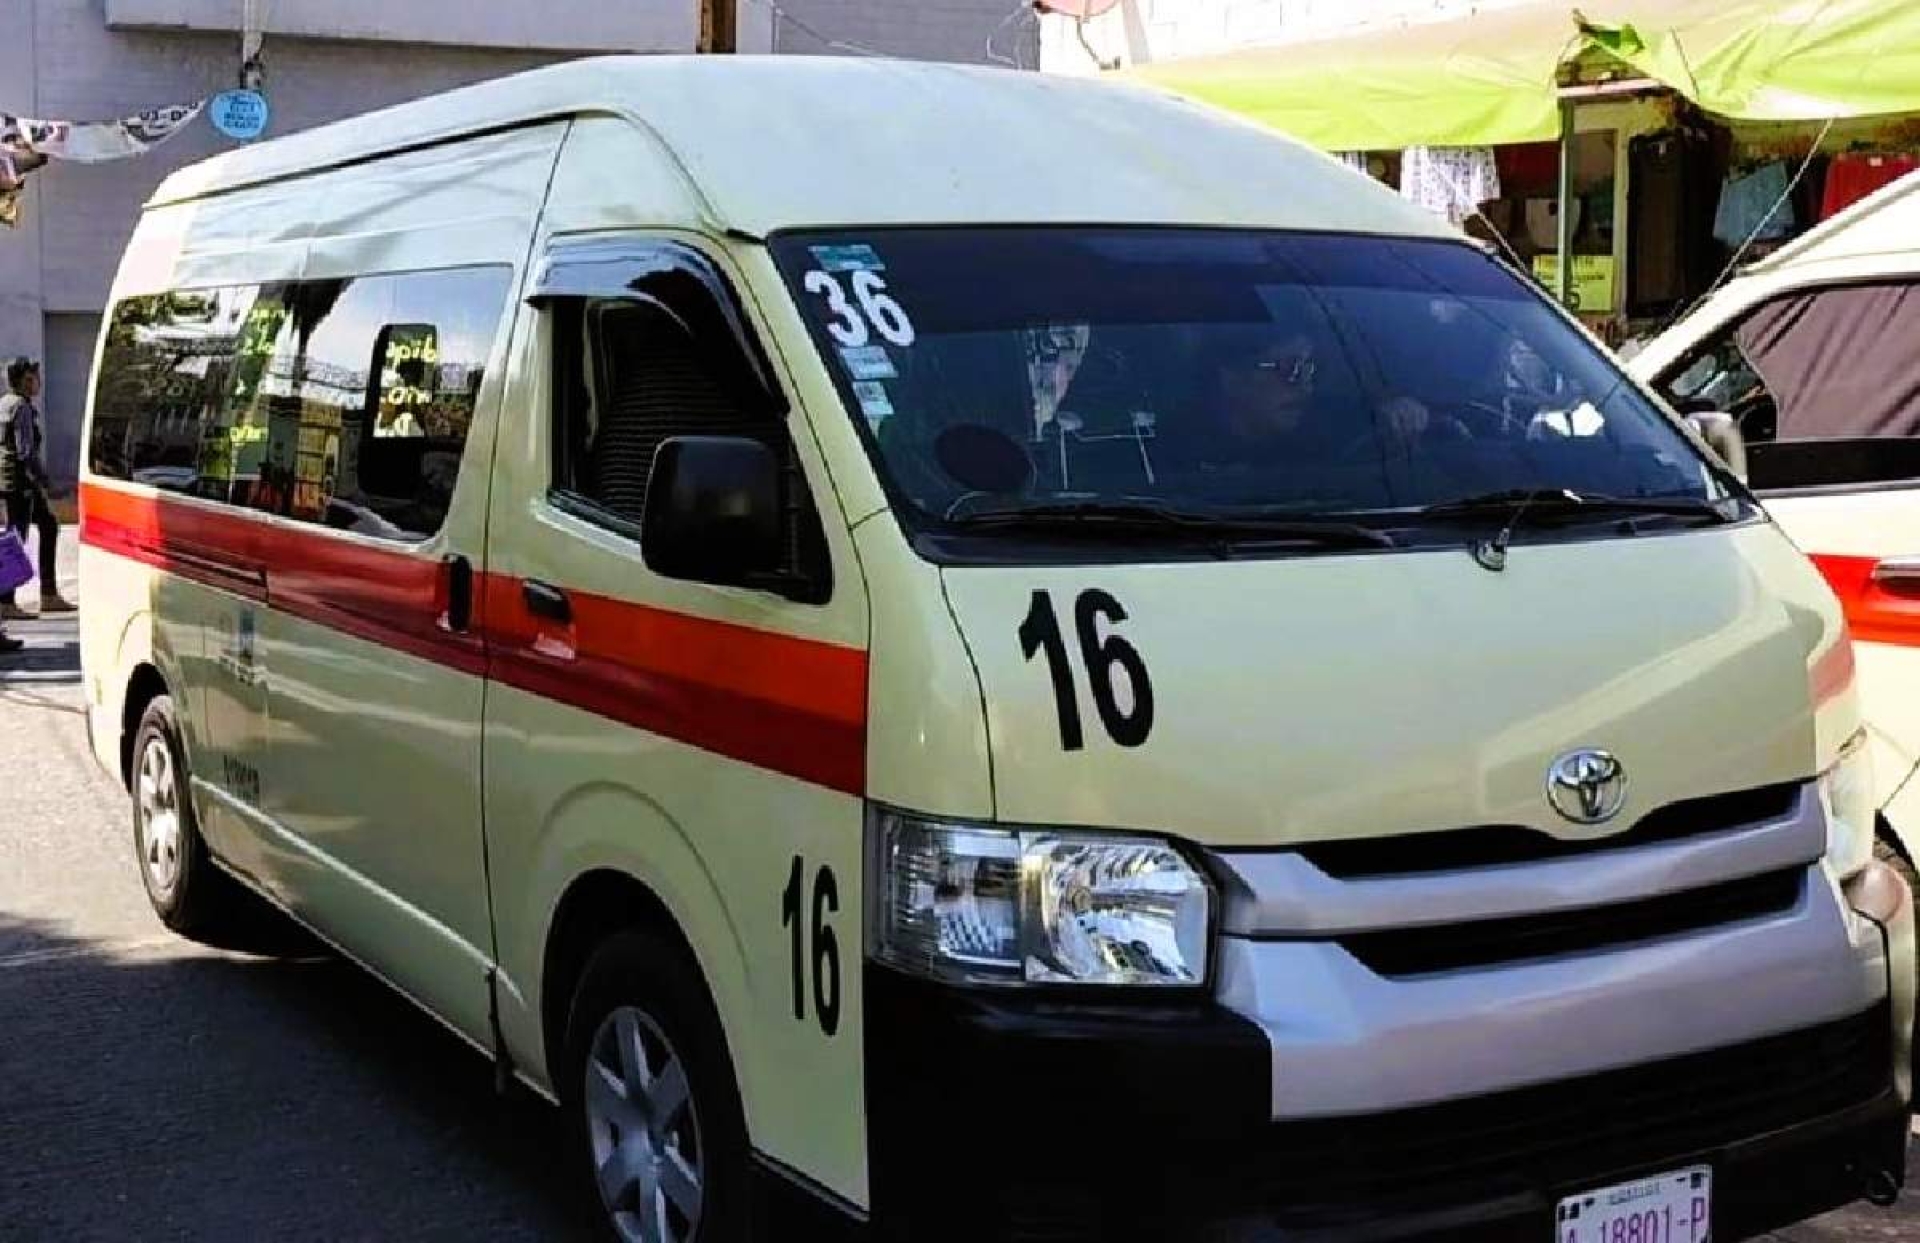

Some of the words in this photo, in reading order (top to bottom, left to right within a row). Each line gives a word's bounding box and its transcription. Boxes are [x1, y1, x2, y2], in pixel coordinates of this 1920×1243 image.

[804, 269, 915, 347] 36
[1018, 588, 1155, 752] 16
[782, 855, 841, 1037] 16
